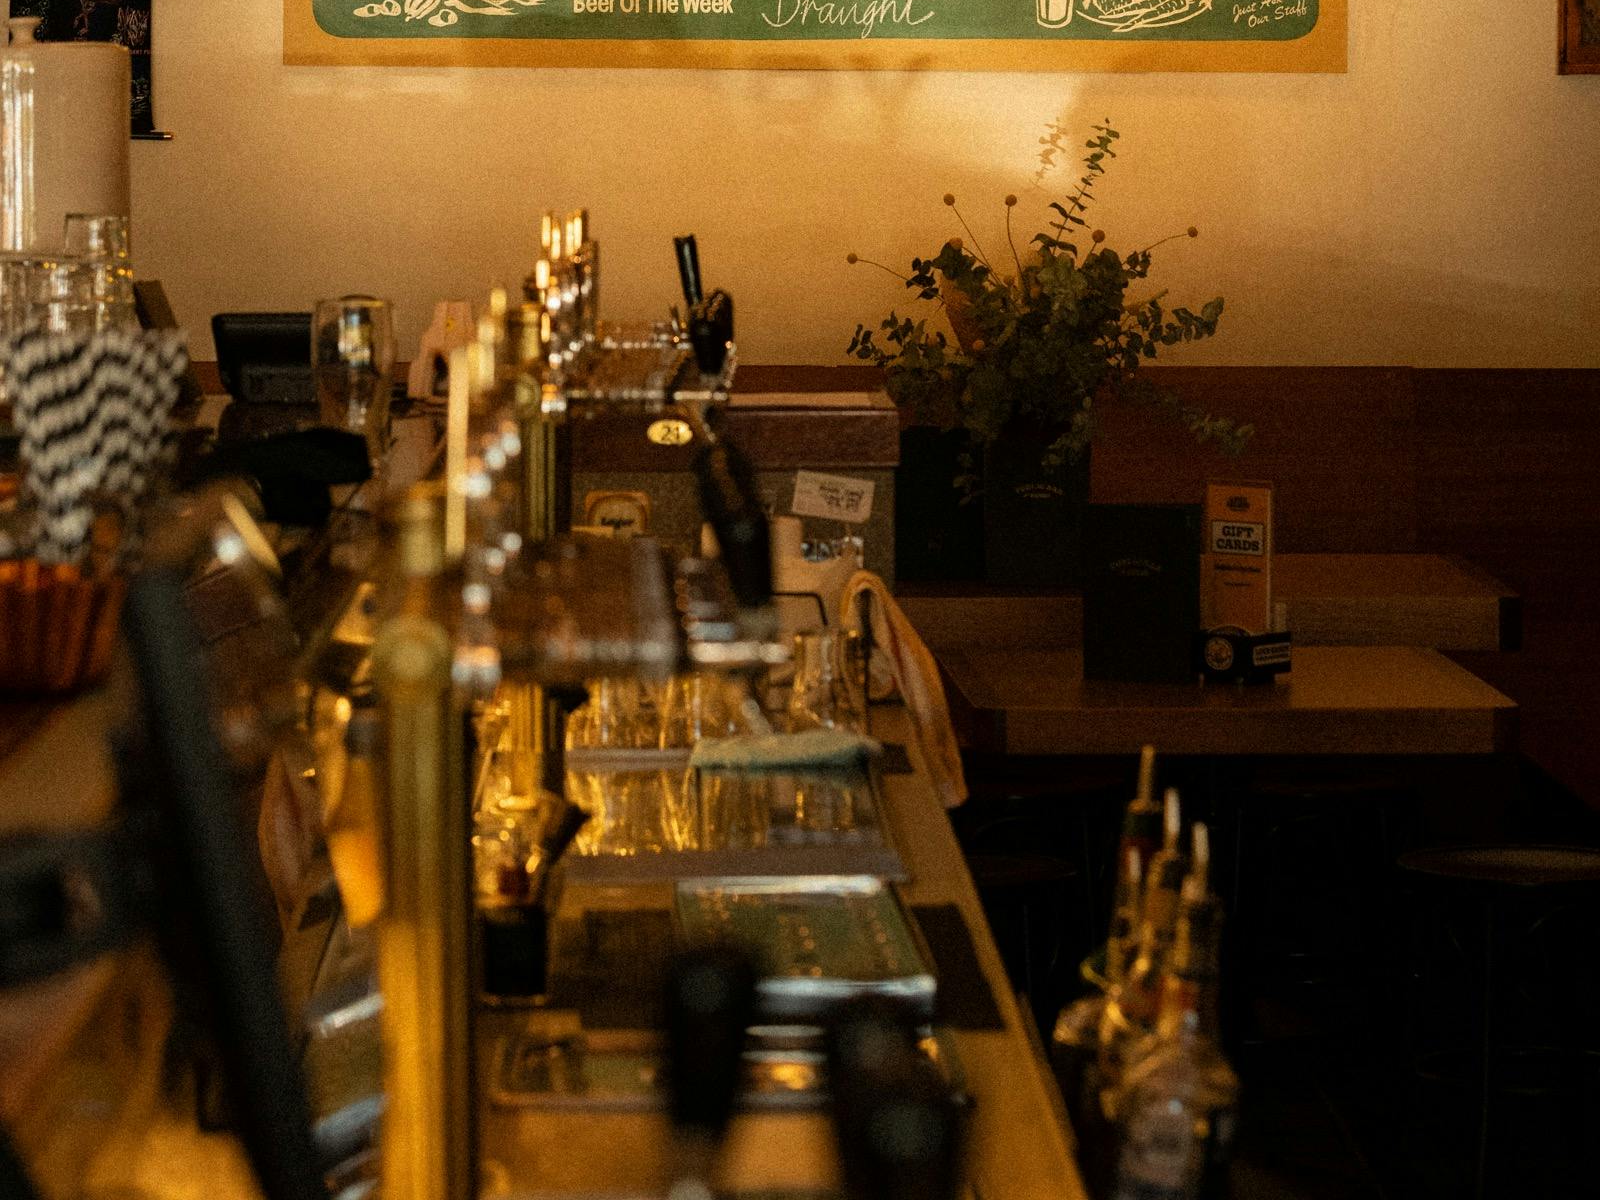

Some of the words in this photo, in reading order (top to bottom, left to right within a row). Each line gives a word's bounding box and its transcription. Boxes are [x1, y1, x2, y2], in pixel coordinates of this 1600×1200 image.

[1233, 2, 1257, 23] Just
[1248, 14, 1269, 28] Our
[1274, 0, 1307, 20] Staff
[1222, 525, 1254, 538] GIFT
[1216, 538, 1260, 552] CARDS
